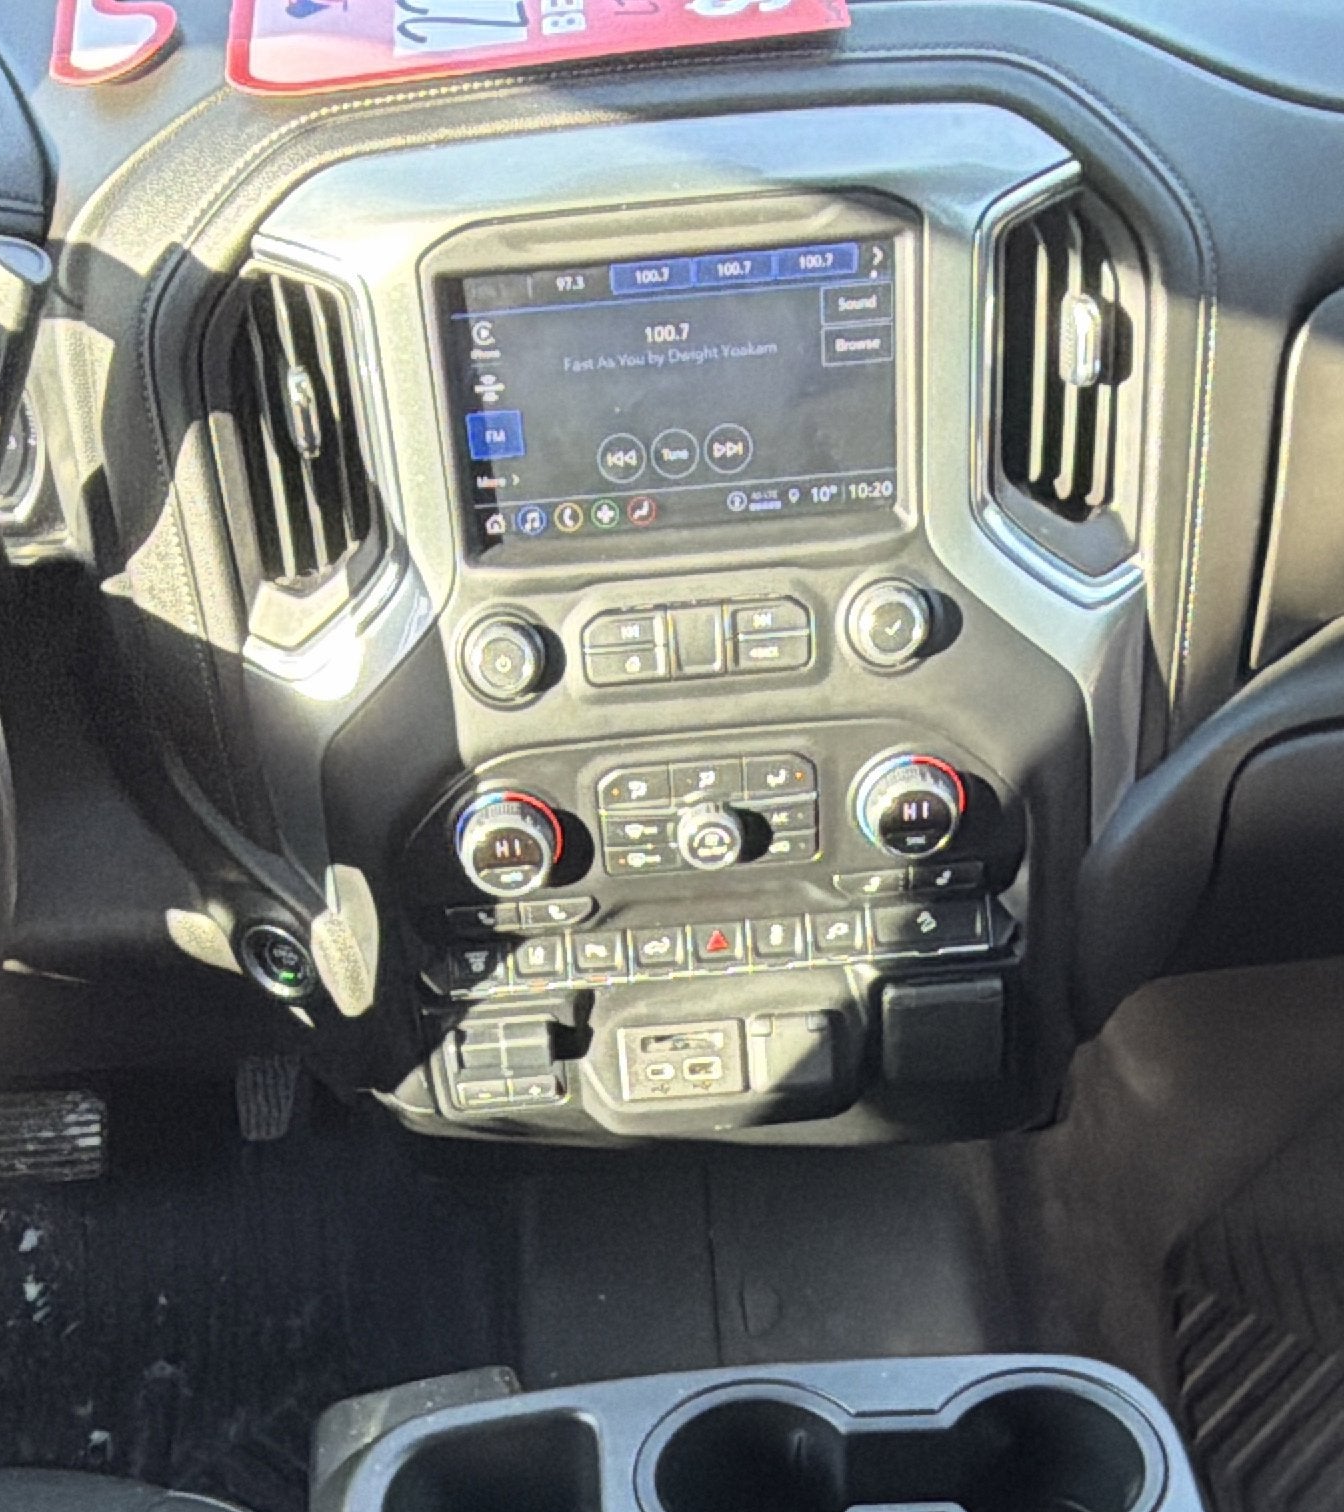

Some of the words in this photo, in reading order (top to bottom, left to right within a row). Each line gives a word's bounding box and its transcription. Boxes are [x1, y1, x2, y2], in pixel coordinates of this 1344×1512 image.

[716, 260, 752, 277] 100.7
[798, 252, 834, 270] 100.7
[555, 276, 586, 292] 97.3
[634, 267, 670, 284] 100.7
[837, 294, 878, 312] Sound
[643, 322, 690, 344] 100.7
[834, 336, 882, 353] Browse
[563, 356, 594, 372] Fast
[618, 352, 646, 367] You
[647, 350, 666, 368] by
[668, 347, 719, 365] Dwight
[848, 480, 894, 500] 10:20
[902, 800, 931, 822] HI
[494, 838, 523, 859] HI
